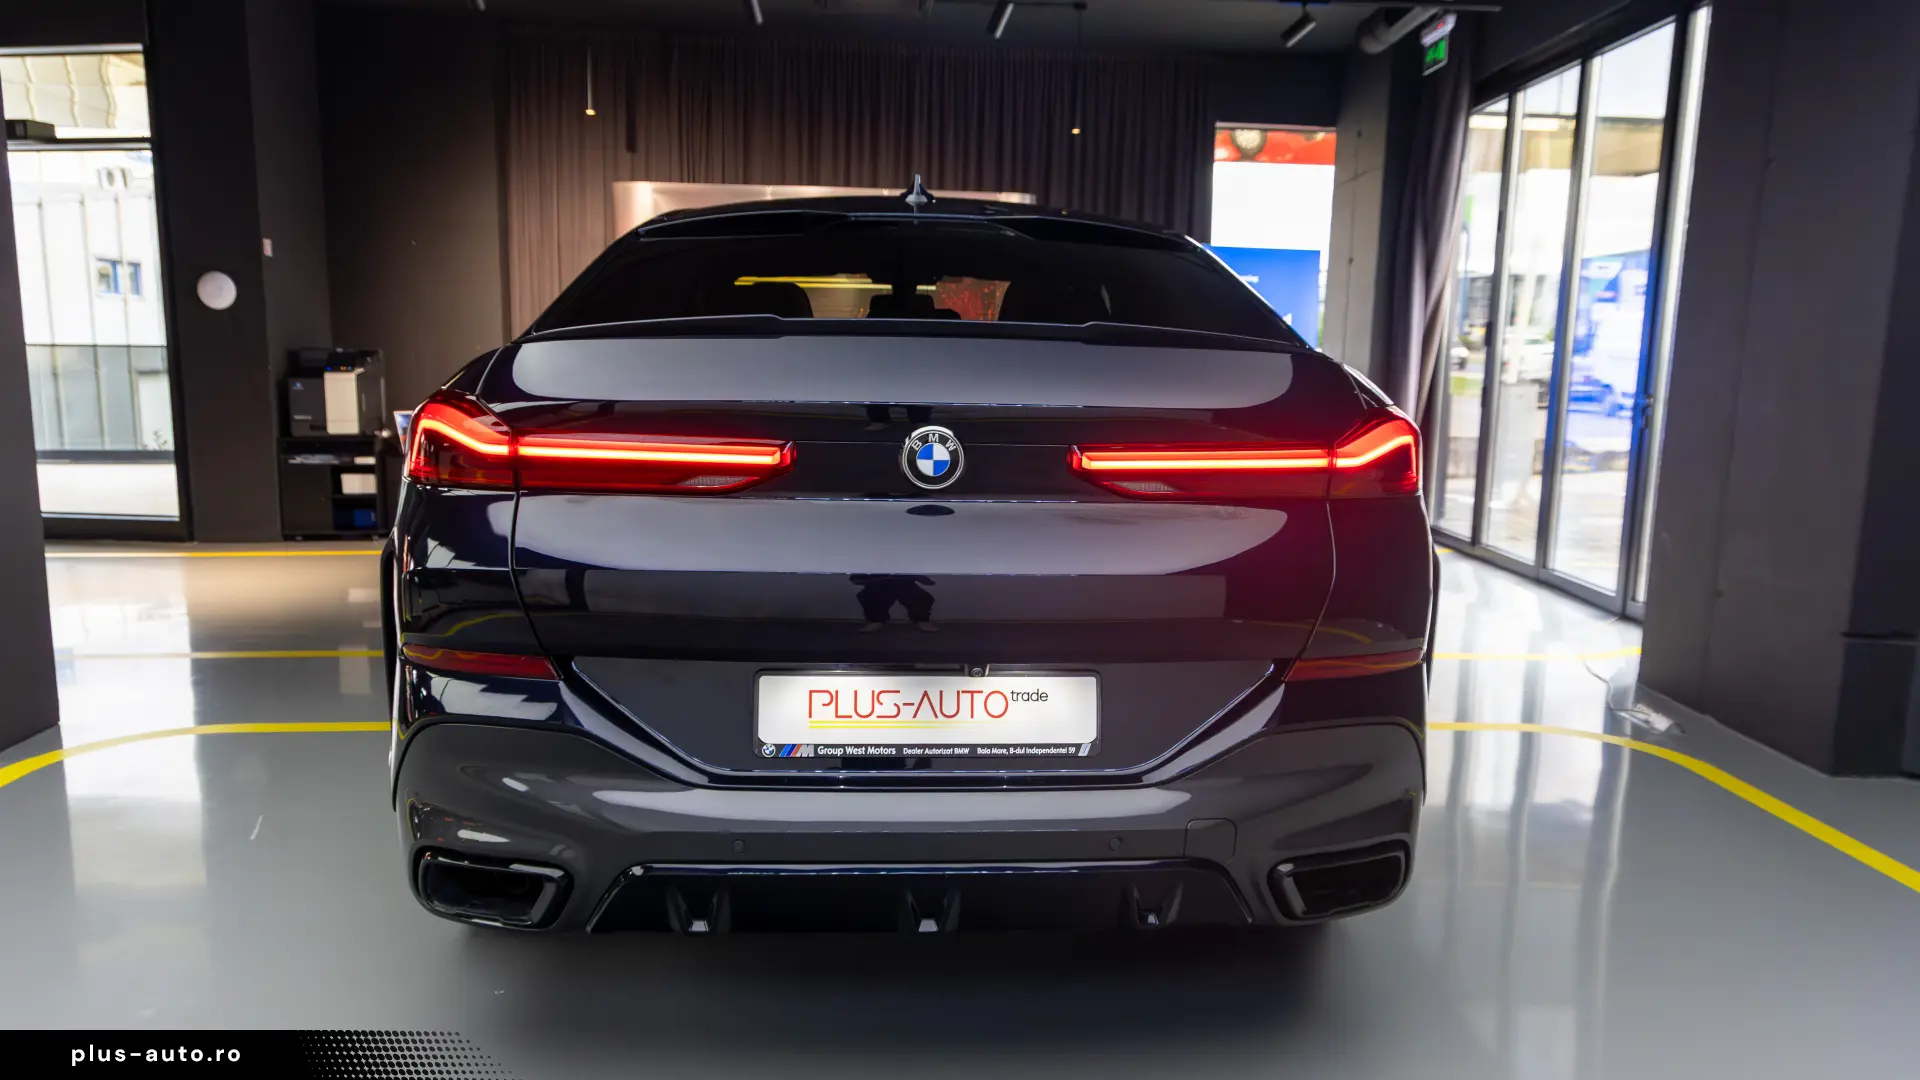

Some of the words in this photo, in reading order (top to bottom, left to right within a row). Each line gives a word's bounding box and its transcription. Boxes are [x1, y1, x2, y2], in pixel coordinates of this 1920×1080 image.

[911, 433, 957, 452] BMW
[808, 689, 1009, 719] PLUS-AUTO
[1010, 689, 1049, 702] trade
[817, 746, 844, 756] Group
[845, 746, 866, 755] West
[867, 746, 896, 755] Motors
[903, 746, 924, 754] Dealer
[991, 747, 1009, 756] Mare,
[1068, 746, 1076, 754] 59
